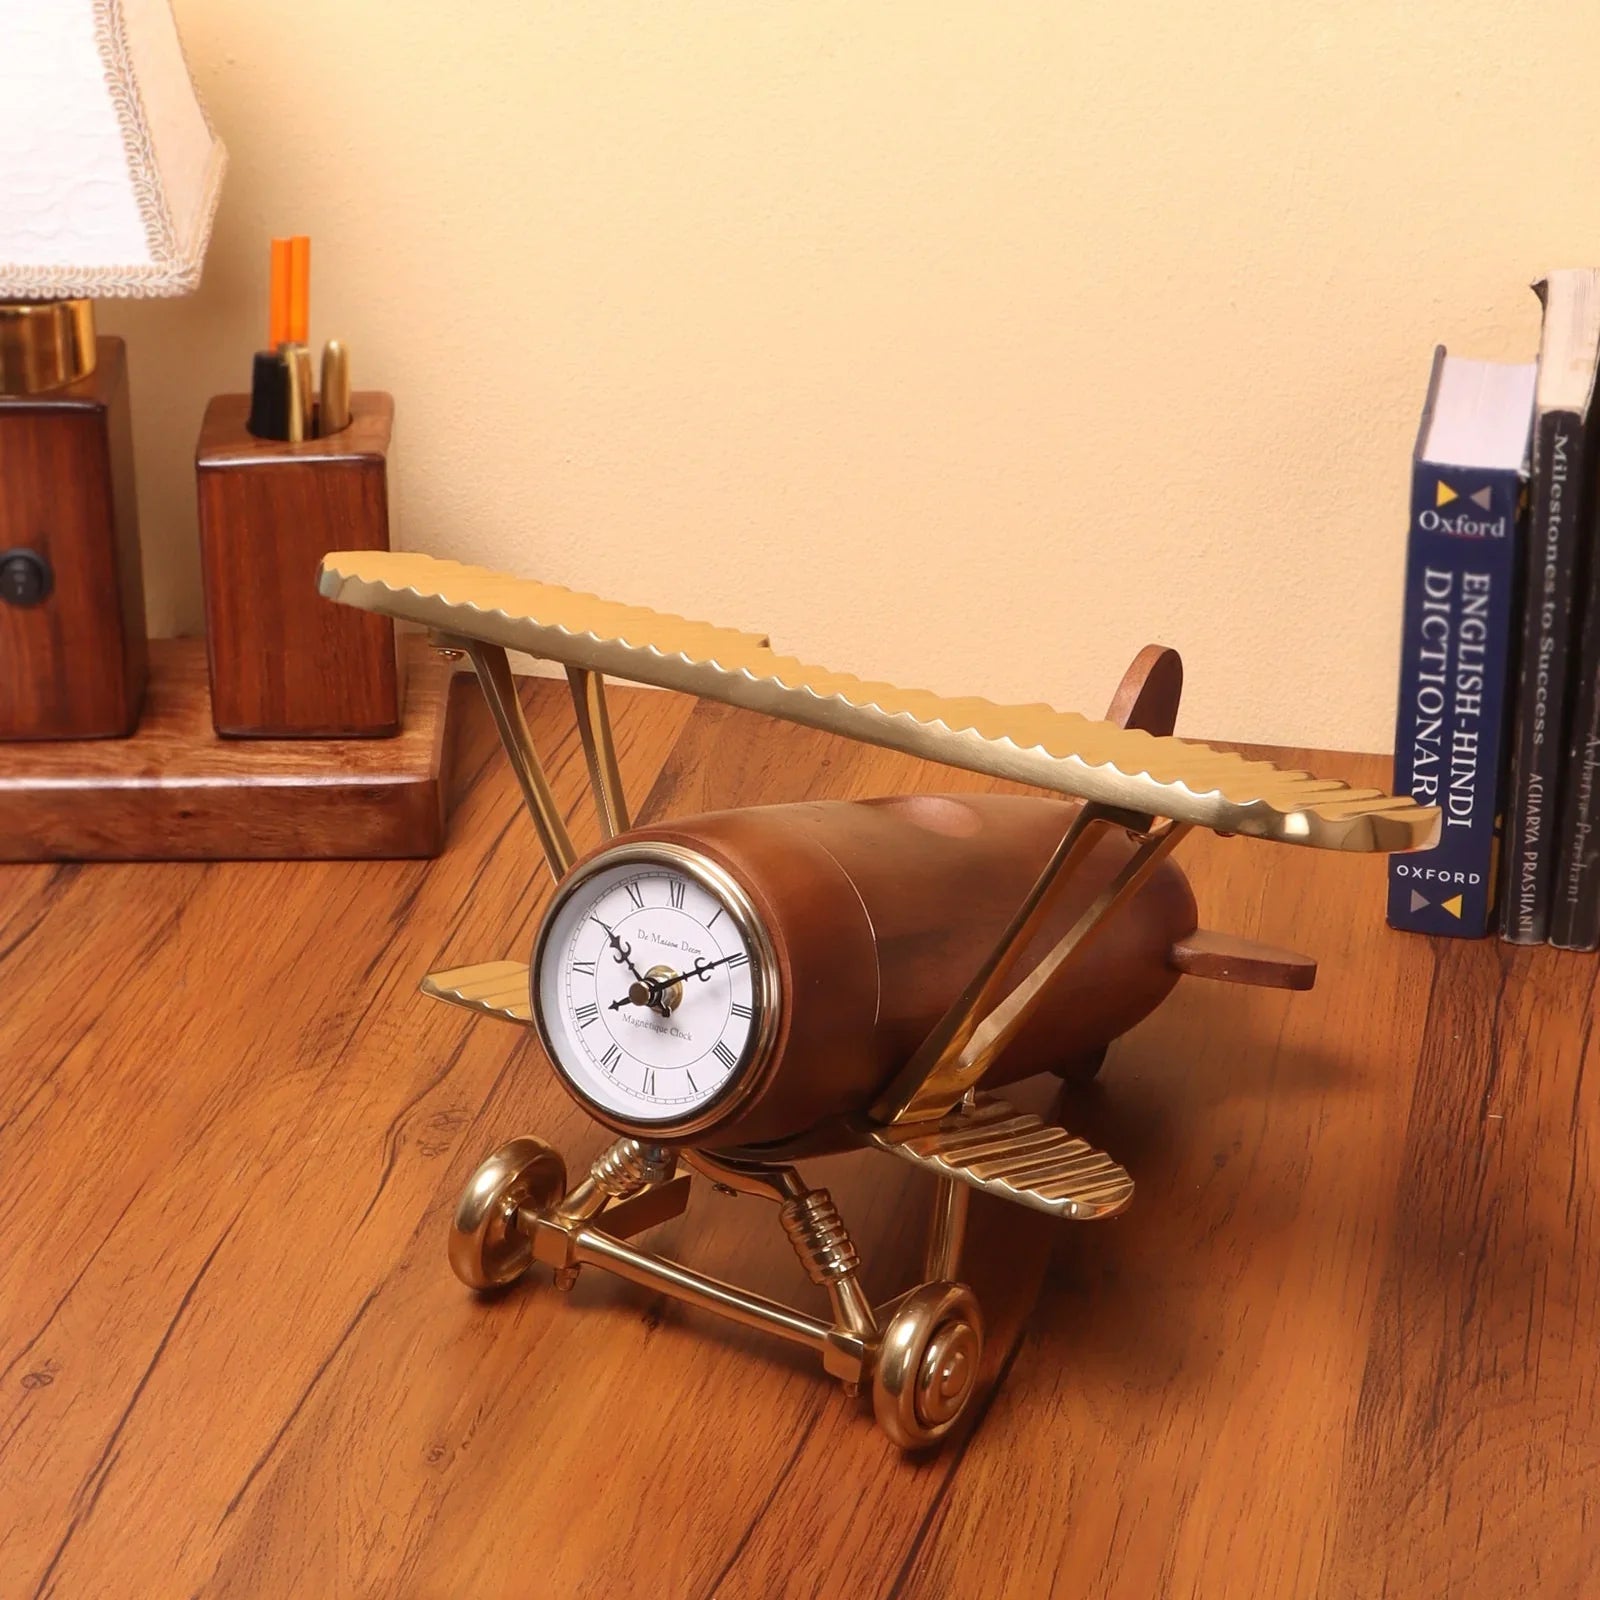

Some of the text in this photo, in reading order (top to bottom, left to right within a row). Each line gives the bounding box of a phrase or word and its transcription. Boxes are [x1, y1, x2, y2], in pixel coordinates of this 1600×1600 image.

[1418, 509, 1506, 538] Oxford
[1533, 434, 1569, 745] Milestones to Success
[1446, 571, 1491, 829] ENGLISH-HINDI
[1518, 772, 1544, 933] ACHARYA PRASHANT
[1396, 864, 1481, 885] OXFORD
[665, 879, 686, 910] XII
[669, 1026, 693, 1042] Clock
